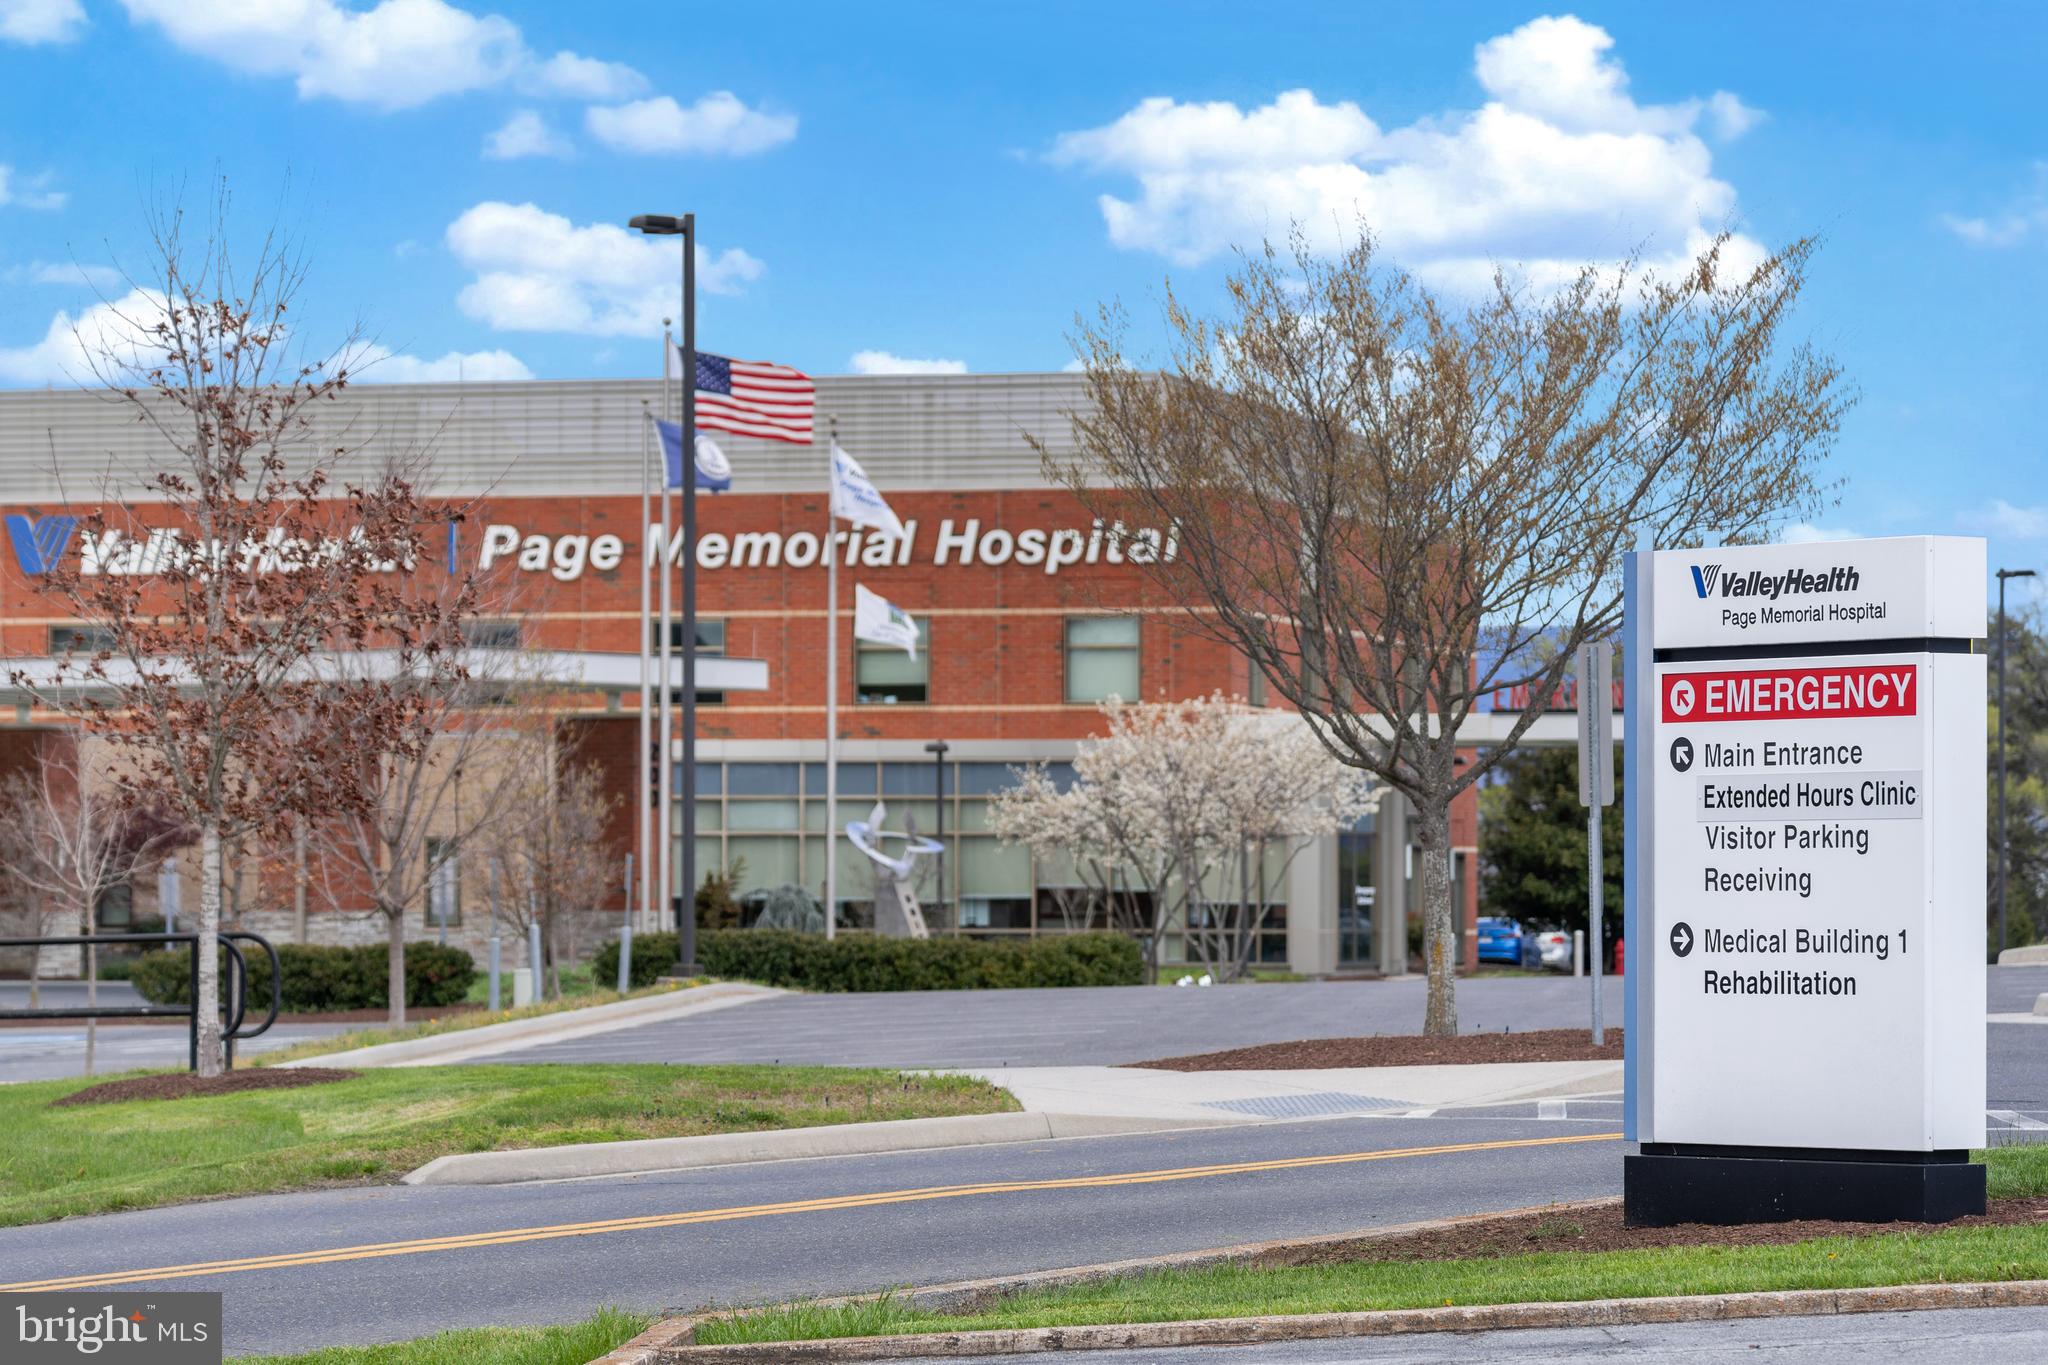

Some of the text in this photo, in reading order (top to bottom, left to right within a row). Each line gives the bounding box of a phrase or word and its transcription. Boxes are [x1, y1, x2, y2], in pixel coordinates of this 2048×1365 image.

[478, 515, 1183, 581] Page Memorial Hospital
[1721, 565, 1860, 601] ValleyHealth
[1722, 602, 1887, 629] Page Memorial Hospital
[1705, 672, 1912, 713] EMERGENCY
[1705, 739, 1863, 767] Main Entrance
[1703, 780, 1917, 809] Extended Hours Clinic
[1705, 824, 1869, 855] Visitor Parking
[1704, 867, 1811, 898] Receiving
[1704, 929, 1907, 960] Medical Building 1
[1704, 970, 1857, 995] Rehabilitation
